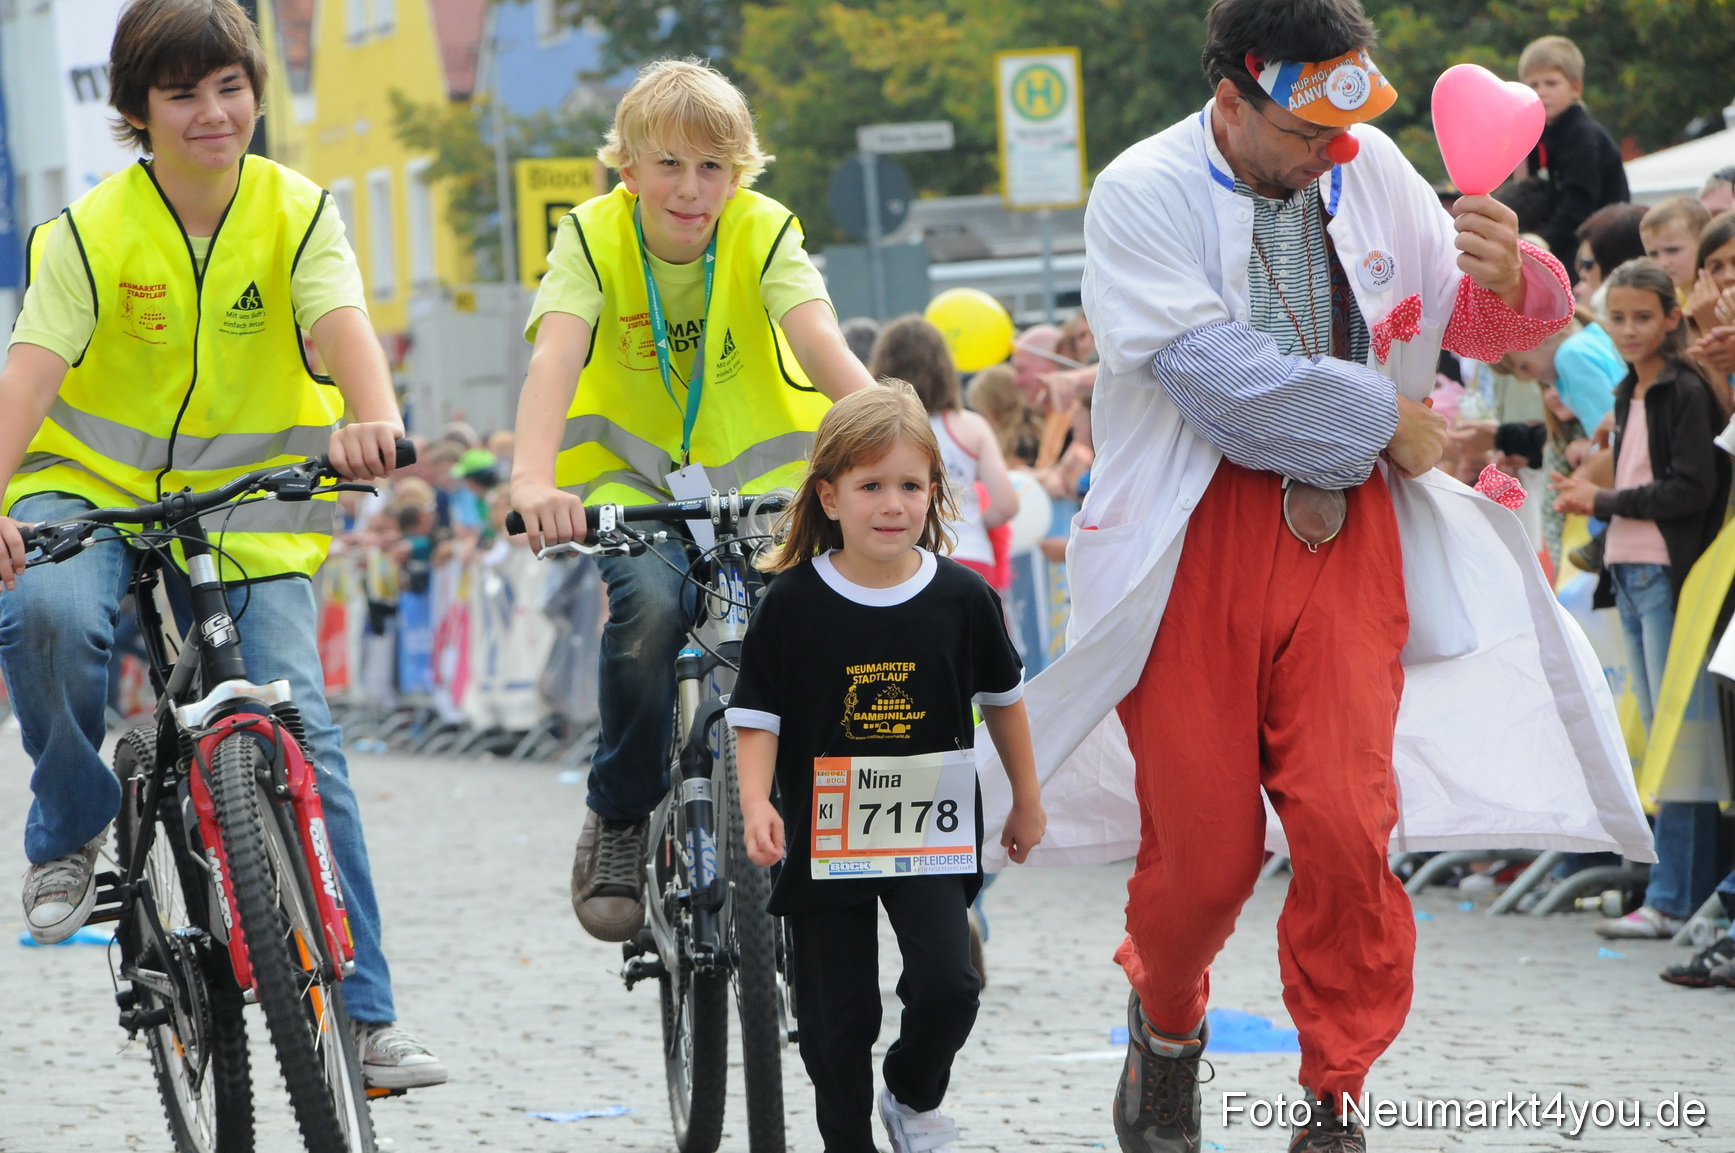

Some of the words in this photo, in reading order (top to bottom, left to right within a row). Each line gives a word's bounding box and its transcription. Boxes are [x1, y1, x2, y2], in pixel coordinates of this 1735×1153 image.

[1291, 78, 1309, 93] HUP
[1025, 78, 1052, 108] H
[127, 289, 167, 299] STADTLAUF
[226, 311, 238, 319] Mit
[846, 662, 916, 675] NEUMARKTER
[852, 672, 909, 685] STADTLAUF
[853, 710, 927, 721] BAMBINILAUF
[858, 768, 902, 790] Nina
[859, 799, 959, 835] 7178
[829, 861, 872, 871] BOCK
[913, 854, 974, 867] PFLEIDERER
